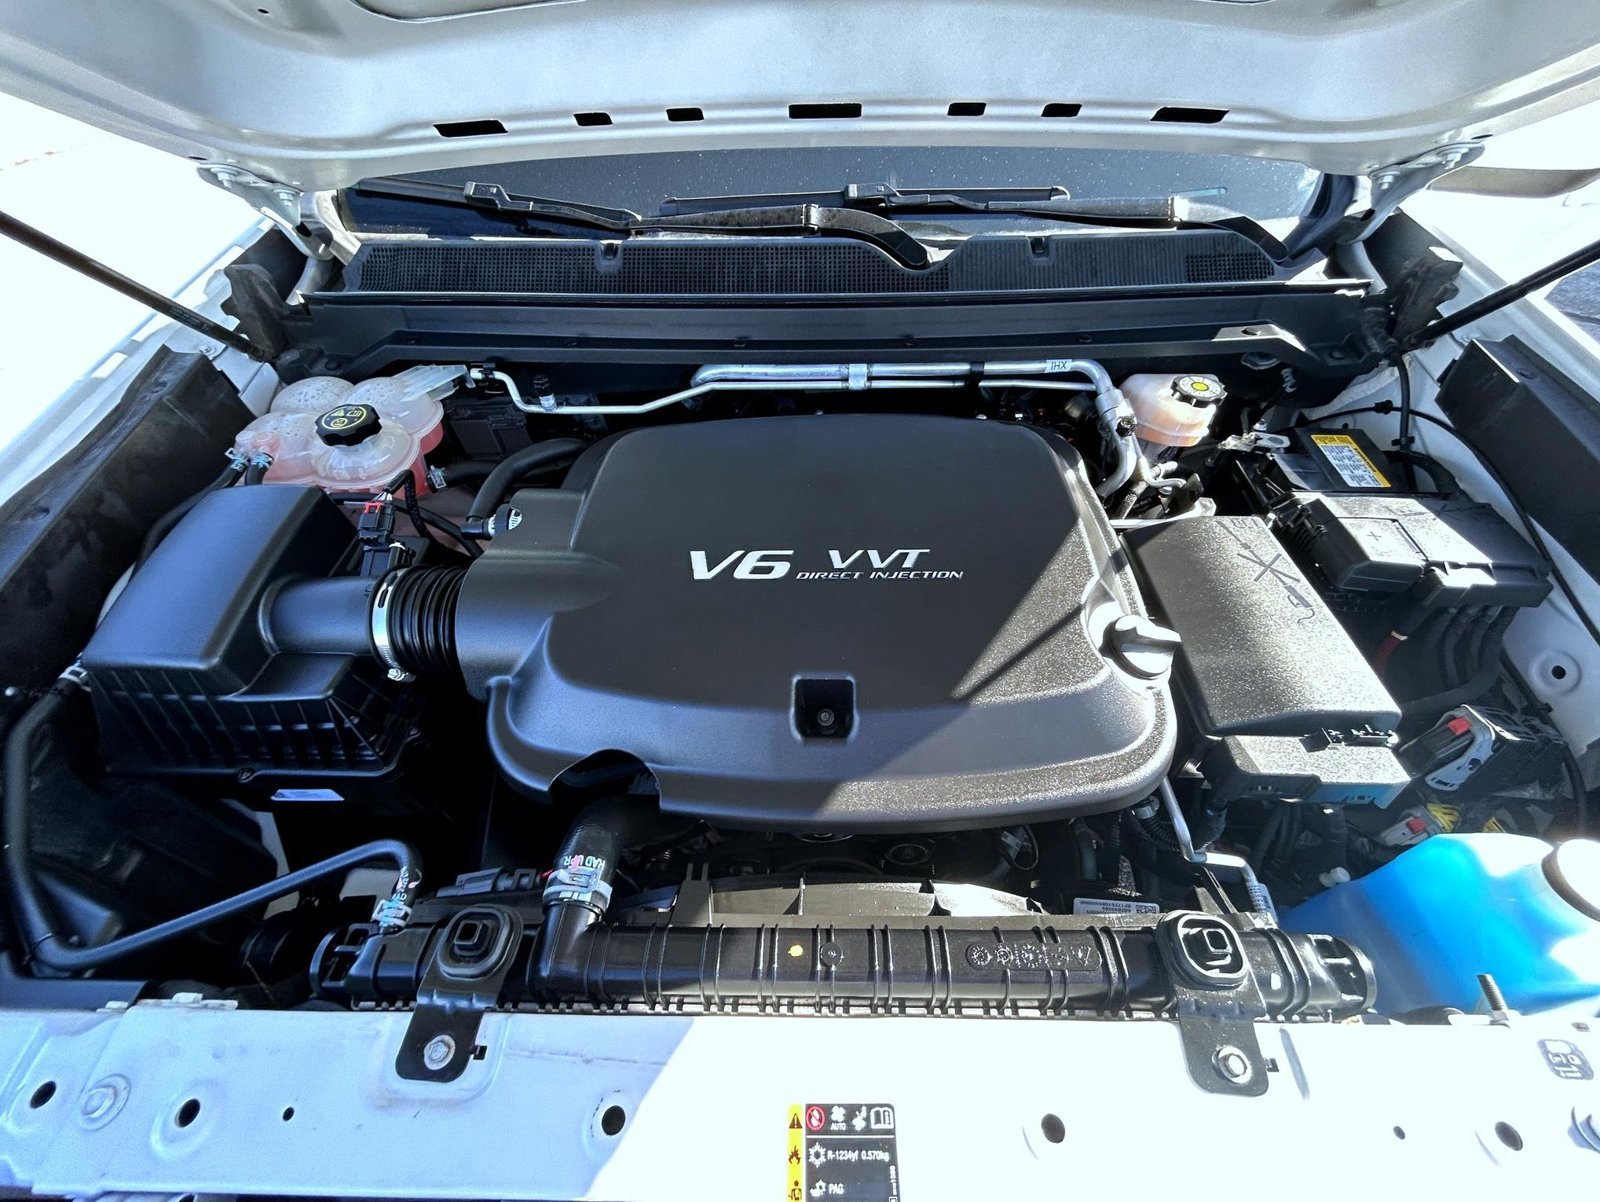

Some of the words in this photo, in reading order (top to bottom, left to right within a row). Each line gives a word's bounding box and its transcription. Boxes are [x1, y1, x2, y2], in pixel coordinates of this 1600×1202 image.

[690, 551, 794, 580] V6
[828, 549, 930, 569] VVT
[796, 571, 864, 580] DIRECT
[869, 571, 964, 580] INJECTION
[585, 856, 606, 870] RAD
[830, 1122, 847, 1131] AUTO
[827, 1150, 859, 1162] R-1234yf
[861, 1149, 890, 1162] 0.570kg
[828, 1183, 844, 1195] PAG
